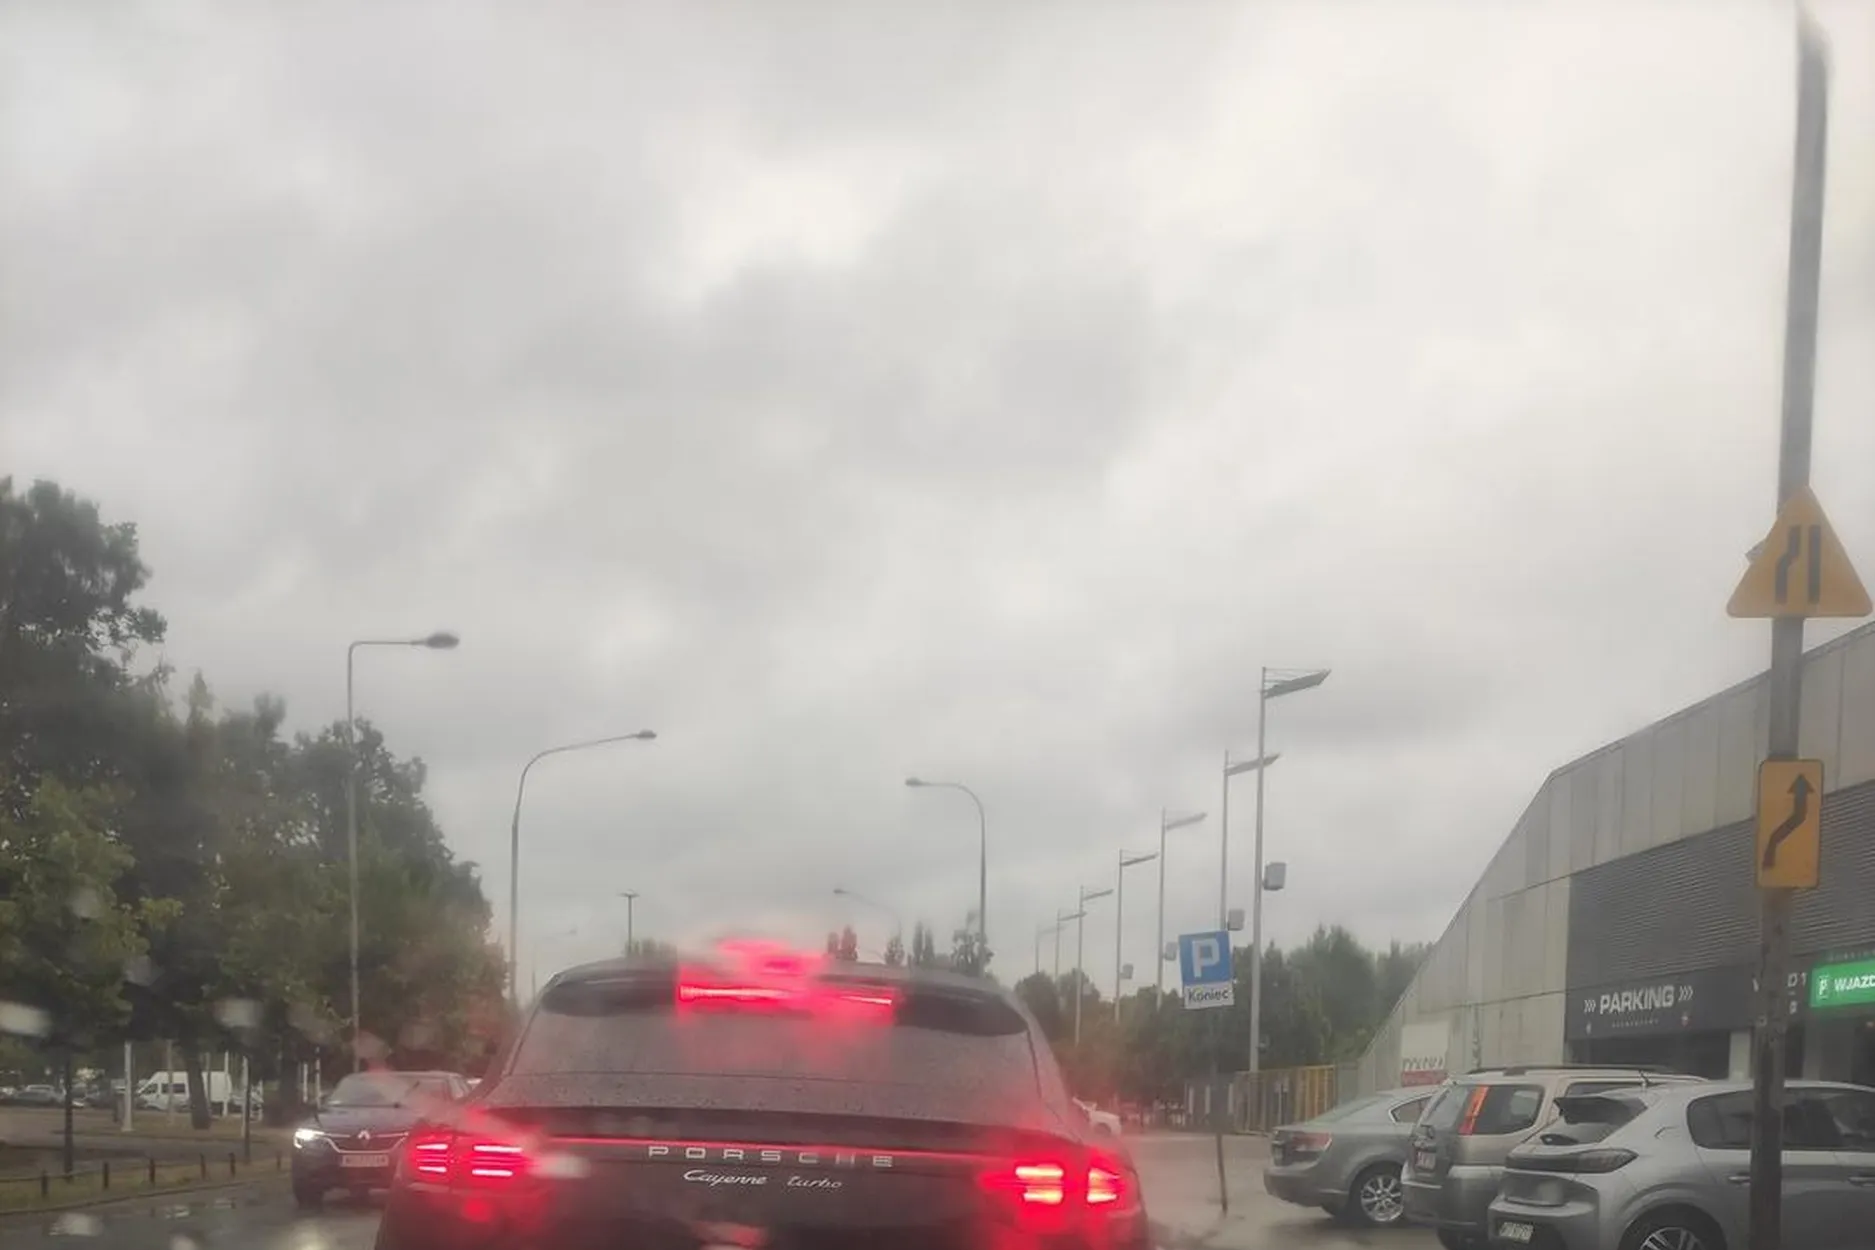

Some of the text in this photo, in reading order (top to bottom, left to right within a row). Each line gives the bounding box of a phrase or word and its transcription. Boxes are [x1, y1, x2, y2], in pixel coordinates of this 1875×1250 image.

[1192, 939, 1220, 978] P
[1188, 985, 1229, 1001] Koniec
[1600, 985, 1675, 1015] PARKING
[648, 1146, 893, 1168] PORSCHE
[683, 1169, 768, 1186] Cayenne
